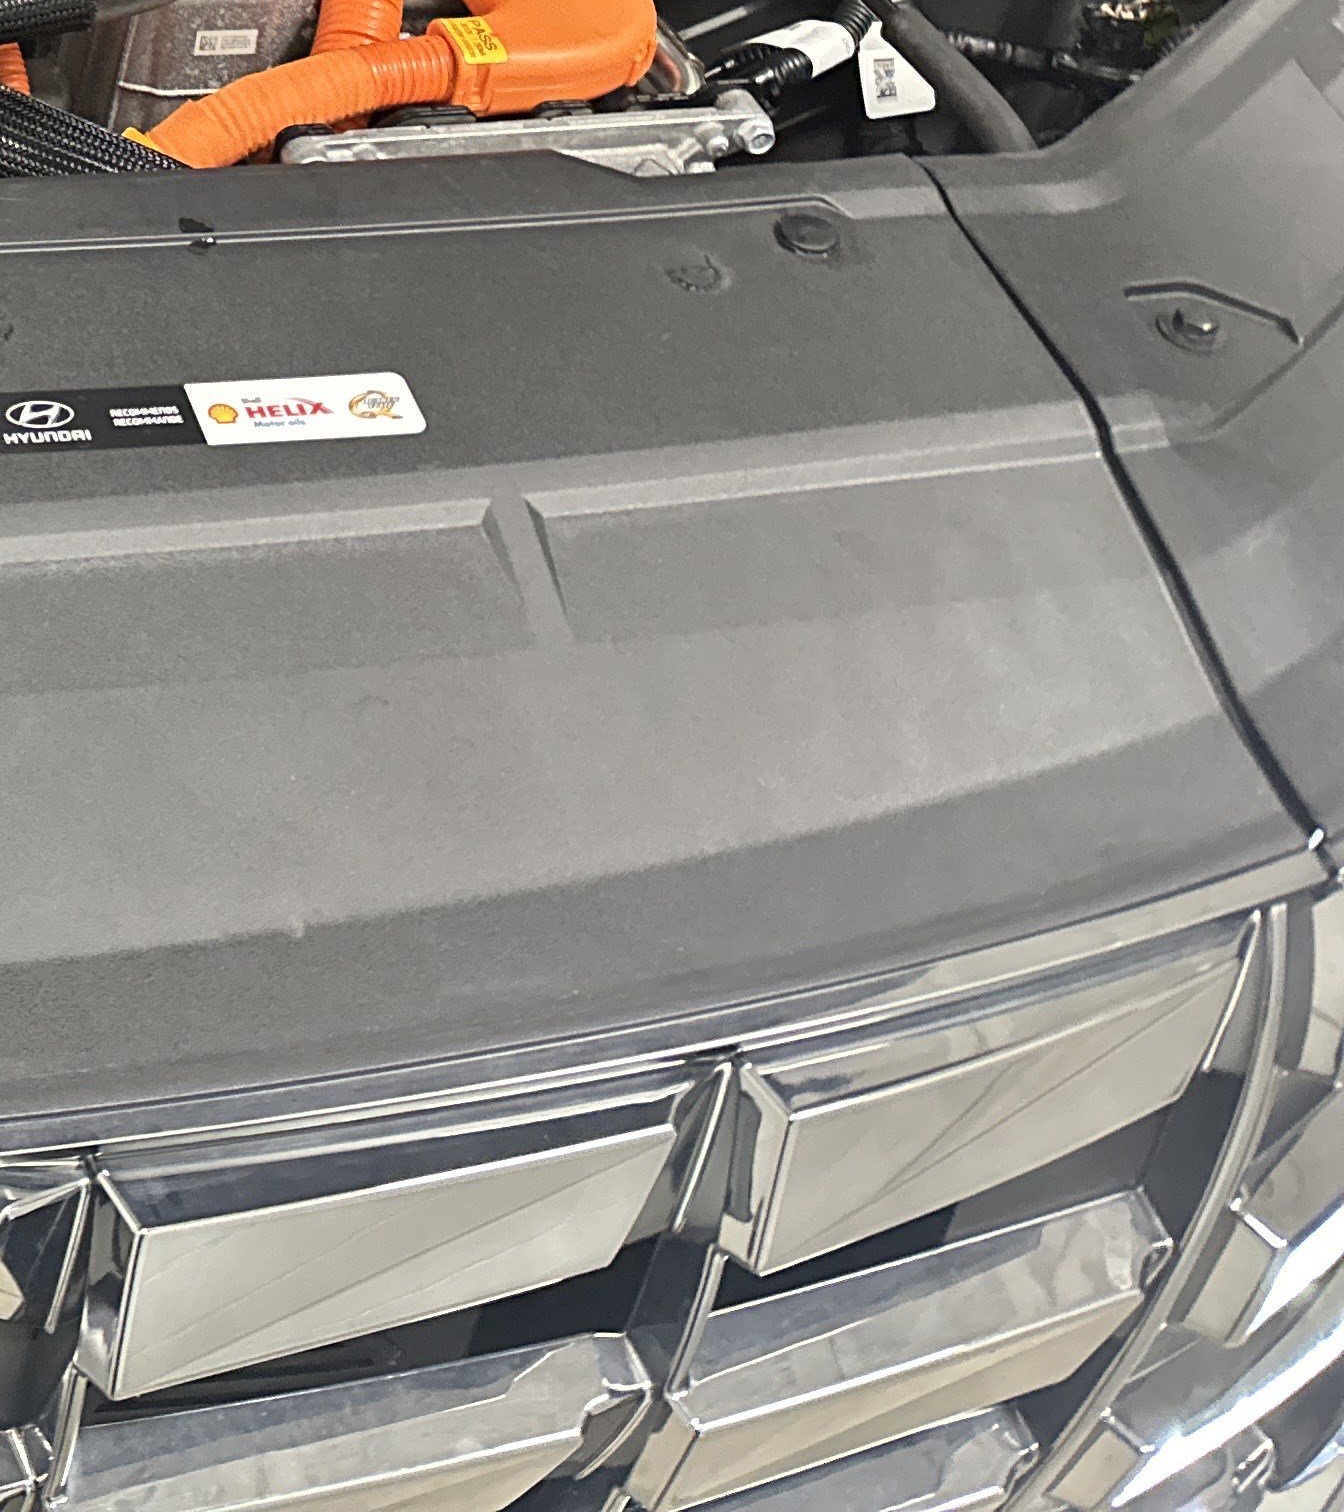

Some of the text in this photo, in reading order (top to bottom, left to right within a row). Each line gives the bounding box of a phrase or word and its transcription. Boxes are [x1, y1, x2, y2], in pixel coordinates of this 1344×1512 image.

[468, 20, 497, 51] PASS
[244, 401, 334, 419] HELIX
[3, 429, 92, 444] HYUNDAI
